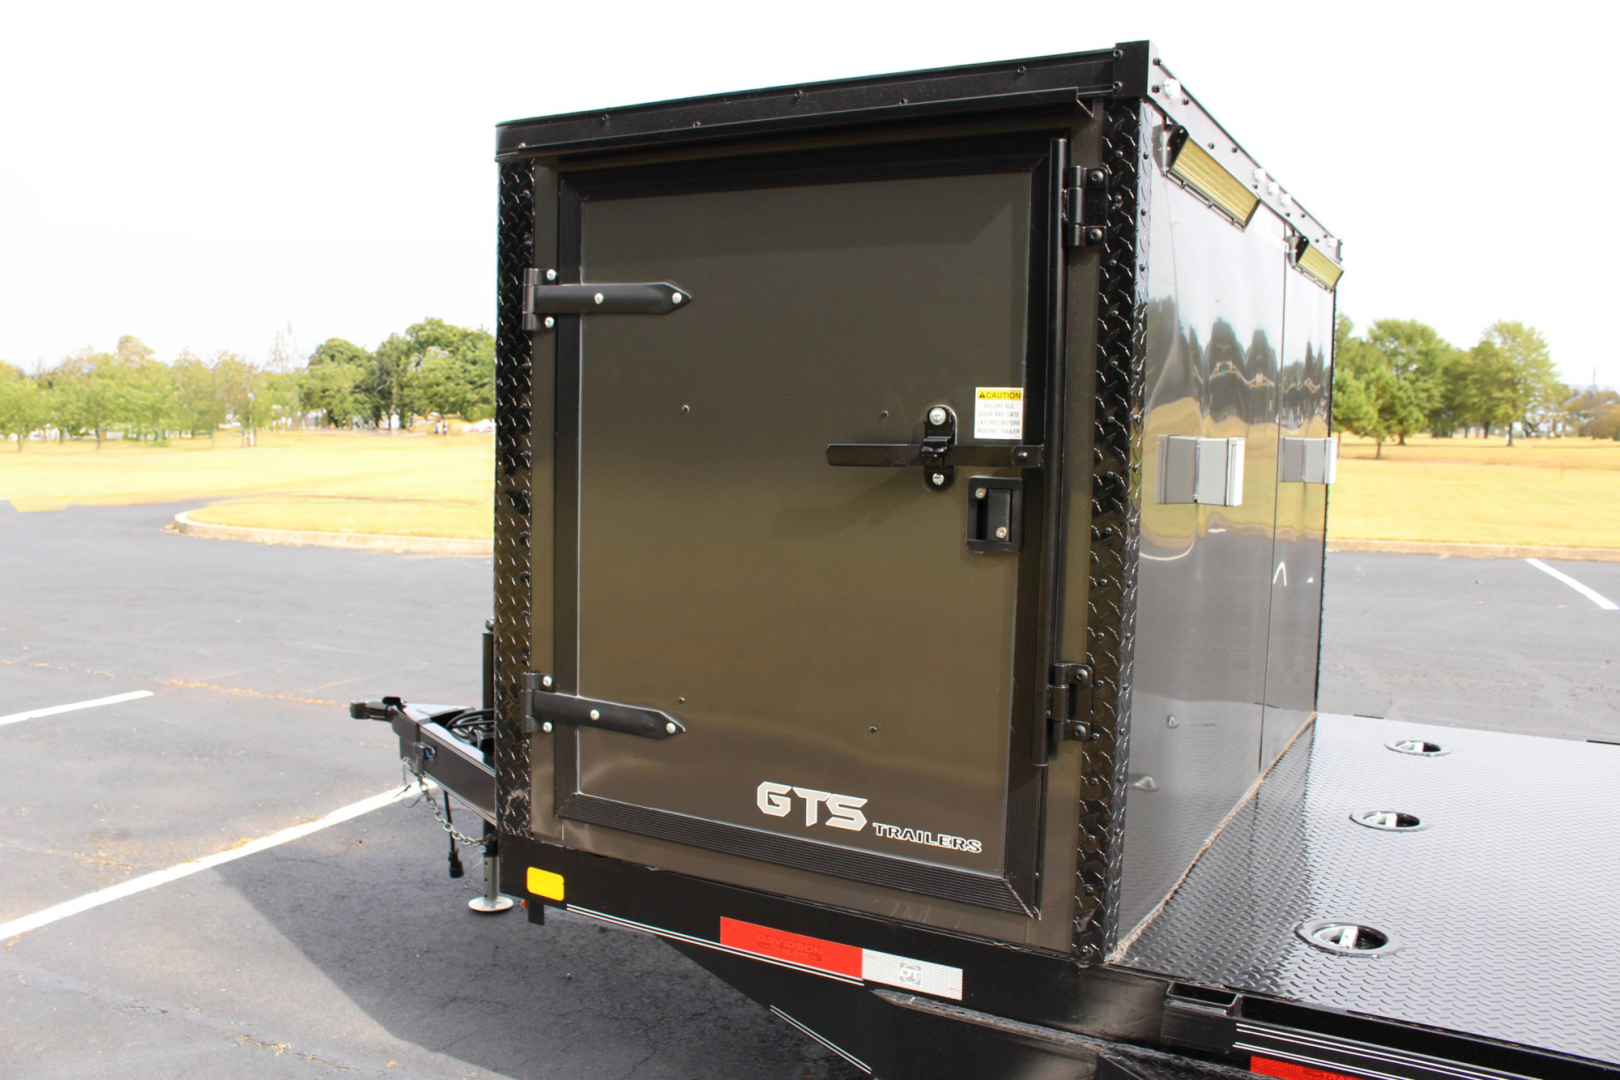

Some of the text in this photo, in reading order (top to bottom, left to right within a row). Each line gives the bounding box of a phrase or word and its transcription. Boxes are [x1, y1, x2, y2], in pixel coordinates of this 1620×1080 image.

[757, 781, 983, 854] GTS TRAILERS
[757, 933, 823, 955] DAVIDSON
